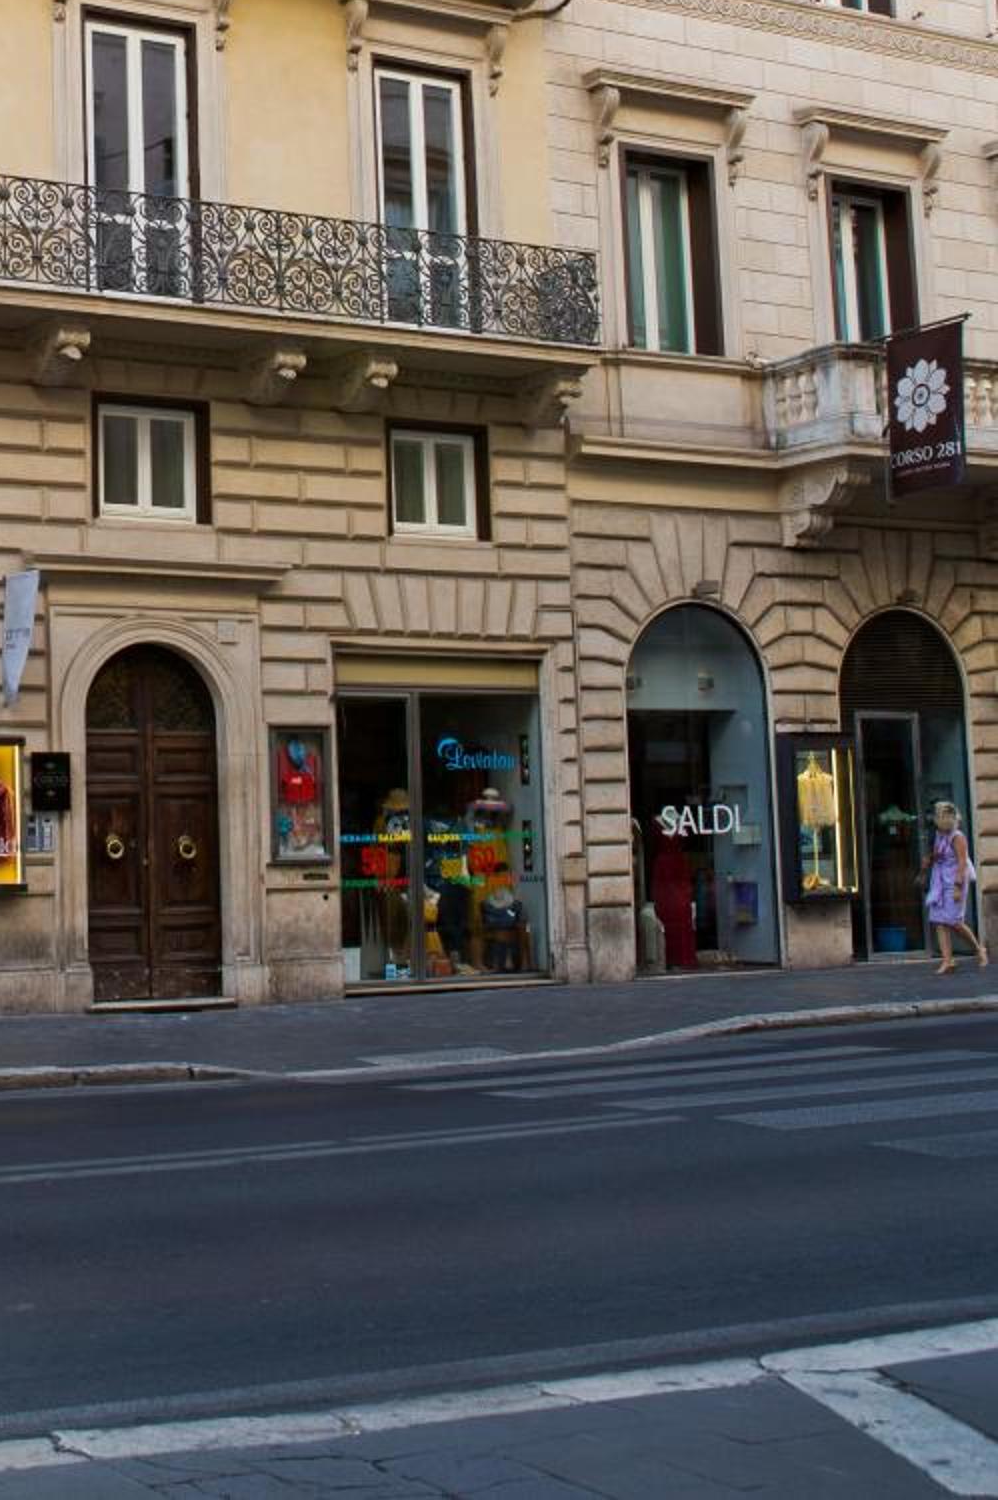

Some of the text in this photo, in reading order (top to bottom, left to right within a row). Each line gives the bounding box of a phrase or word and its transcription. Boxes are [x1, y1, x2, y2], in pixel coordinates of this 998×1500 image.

[891, 446, 933, 469] CORSO
[935, 440, 961, 459] 281
[661, 803, 741, 836] SALDI
